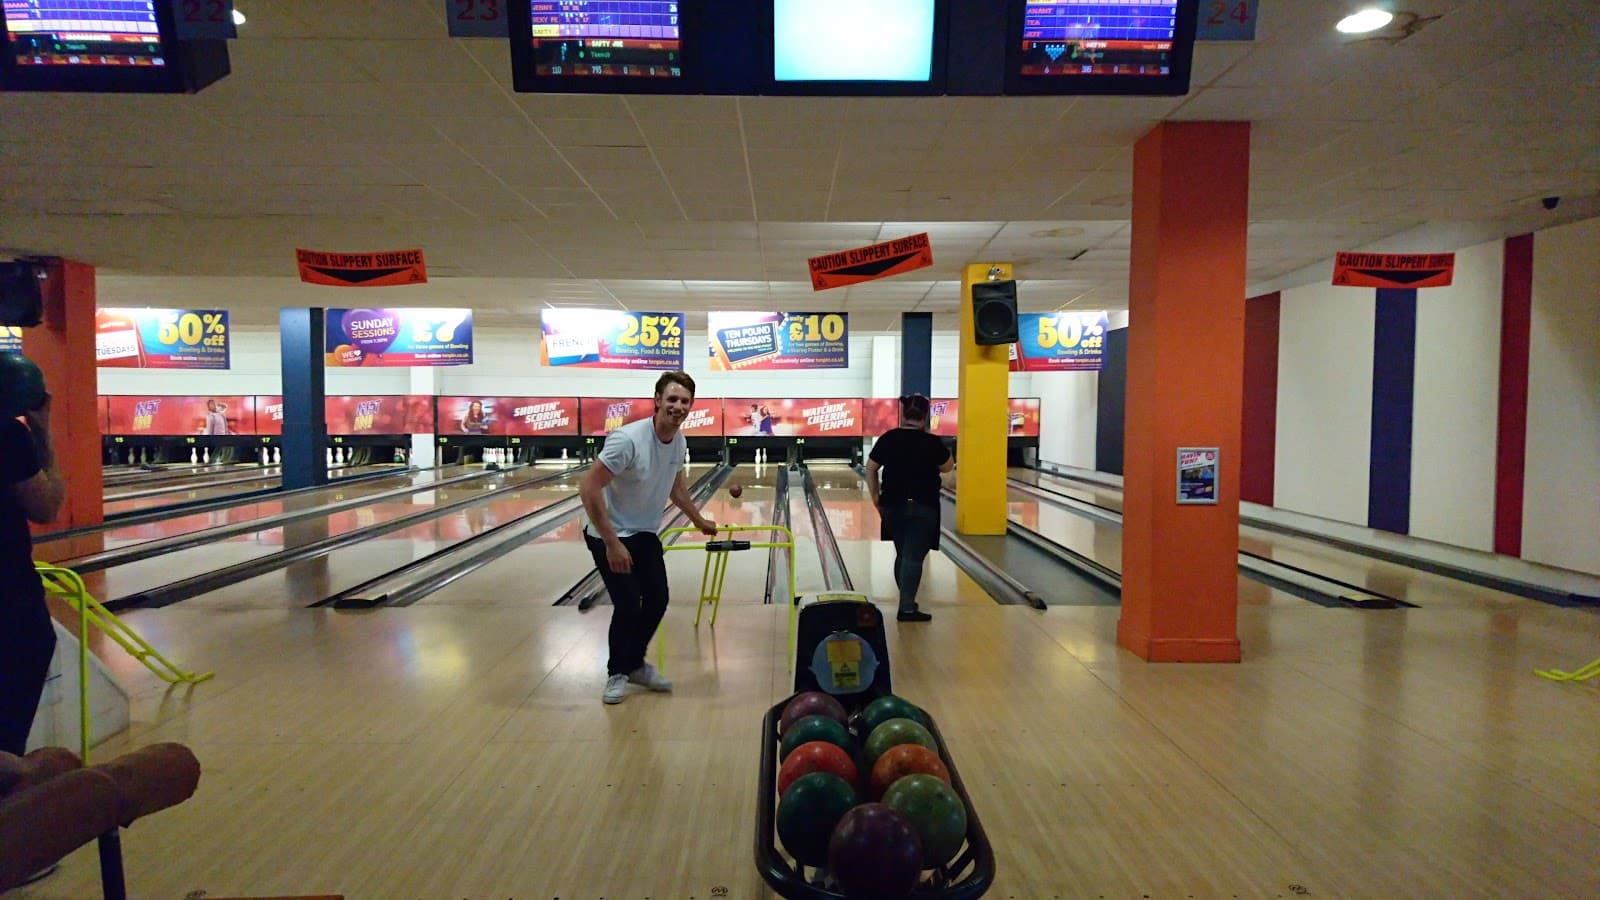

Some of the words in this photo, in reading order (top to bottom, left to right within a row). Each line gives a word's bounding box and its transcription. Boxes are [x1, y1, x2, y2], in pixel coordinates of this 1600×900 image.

[185, 0, 226, 23] 22
[456, 0, 500, 22] 23
[1204, 1, 1249, 25] 24
[329, 254, 373, 268] SLIPPERY
[375, 252, 420, 268] SURFACE
[811, 252, 847, 271] CAUTION
[849, 243, 890, 263] SLIPPERY
[893, 235, 928, 254] SURFACE
[1339, 253, 1382, 267] CAUTION
[1385, 255, 1427, 269] SLIPPERY
[157, 312, 225, 346] 50%
[350, 317, 394, 331] SUNDAY
[617, 315, 681, 347] 25%
[789, 314, 844, 341] £10
[1037, 316, 1104, 348] 50%
[351, 327, 396, 339] SESSIONS
[725, 330, 742, 340] TEN
[742, 325, 771, 337] POUND
[203, 335, 225, 347] off
[660, 337, 681, 348] off
[725, 335, 772, 349] THURSDAYS
[1080, 336, 1103, 348] off
[661, 348, 680, 356] Drinks
[513, 401, 560, 417] SHOOTIN'
[525, 409, 566, 424] SCORIN'
[802, 402, 847, 418] WATCHIN'
[532, 416, 570, 431] TENPIN
[807, 409, 851, 426] CHEERIN'
[819, 417, 854, 432] TENPIN
